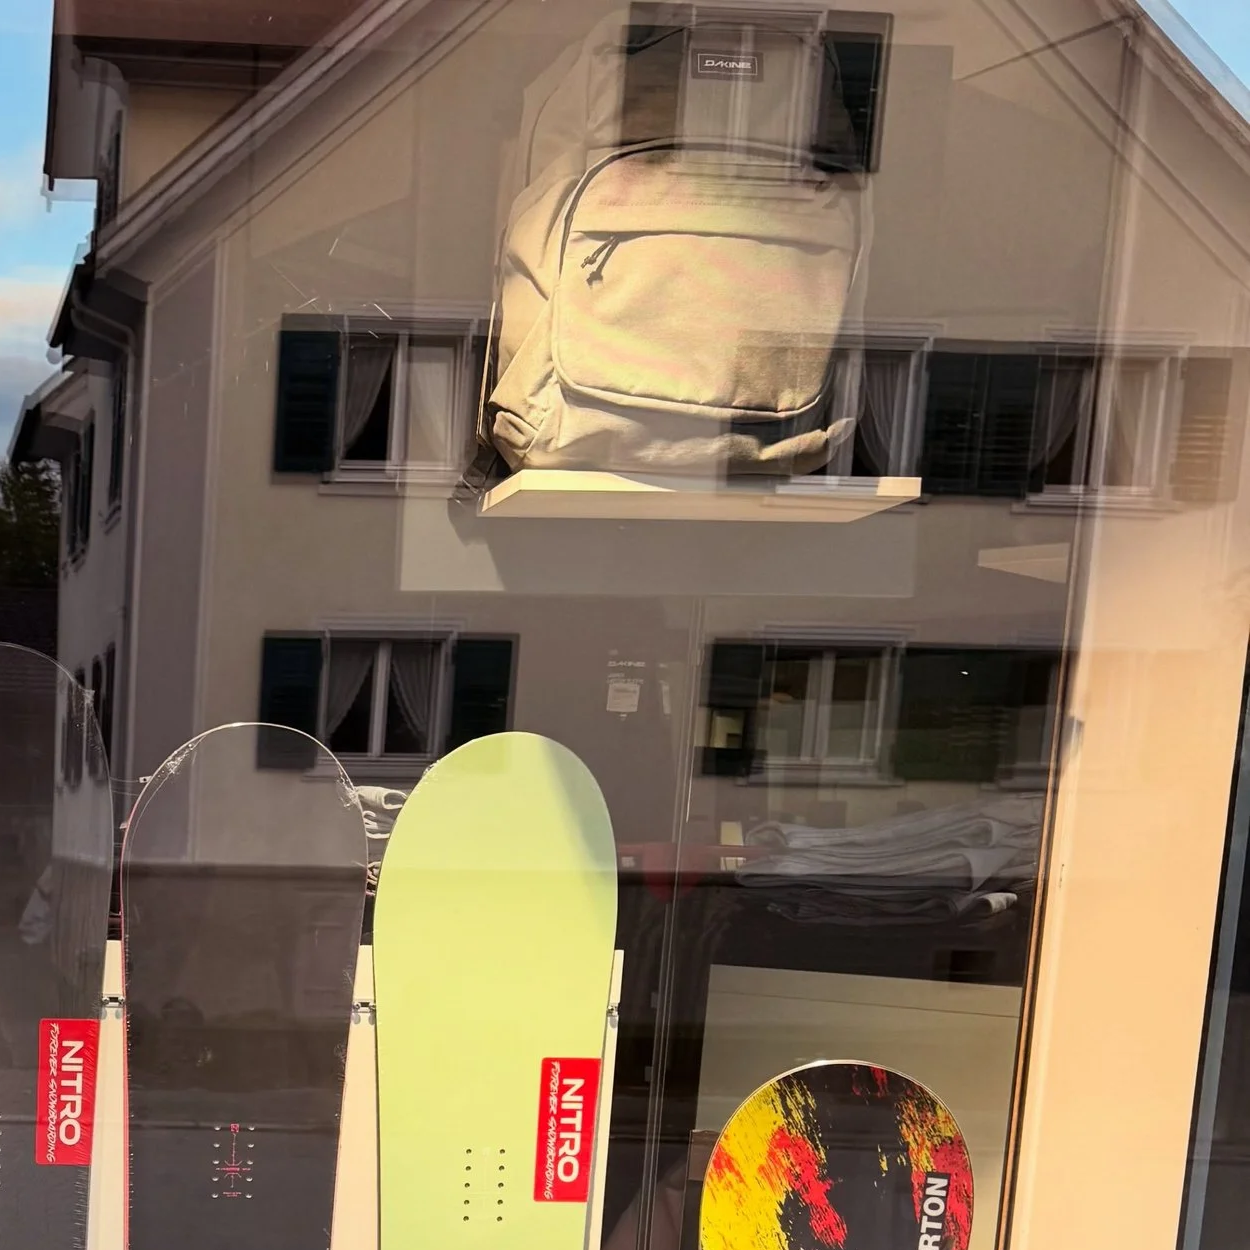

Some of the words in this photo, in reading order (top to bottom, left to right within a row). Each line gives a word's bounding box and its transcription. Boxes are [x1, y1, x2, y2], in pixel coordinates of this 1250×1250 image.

[703, 59, 752, 69] DAKINE
[49, 1022, 60, 1077] FOREVER
[549, 1061, 561, 1115] FOREVER
[46, 1078, 58, 1163] SNOWBOARDING
[59, 1040, 84, 1146] NITRO
[557, 1078, 585, 1183] NITRO
[544, 1116, 557, 1200] SNOWBOARDING
